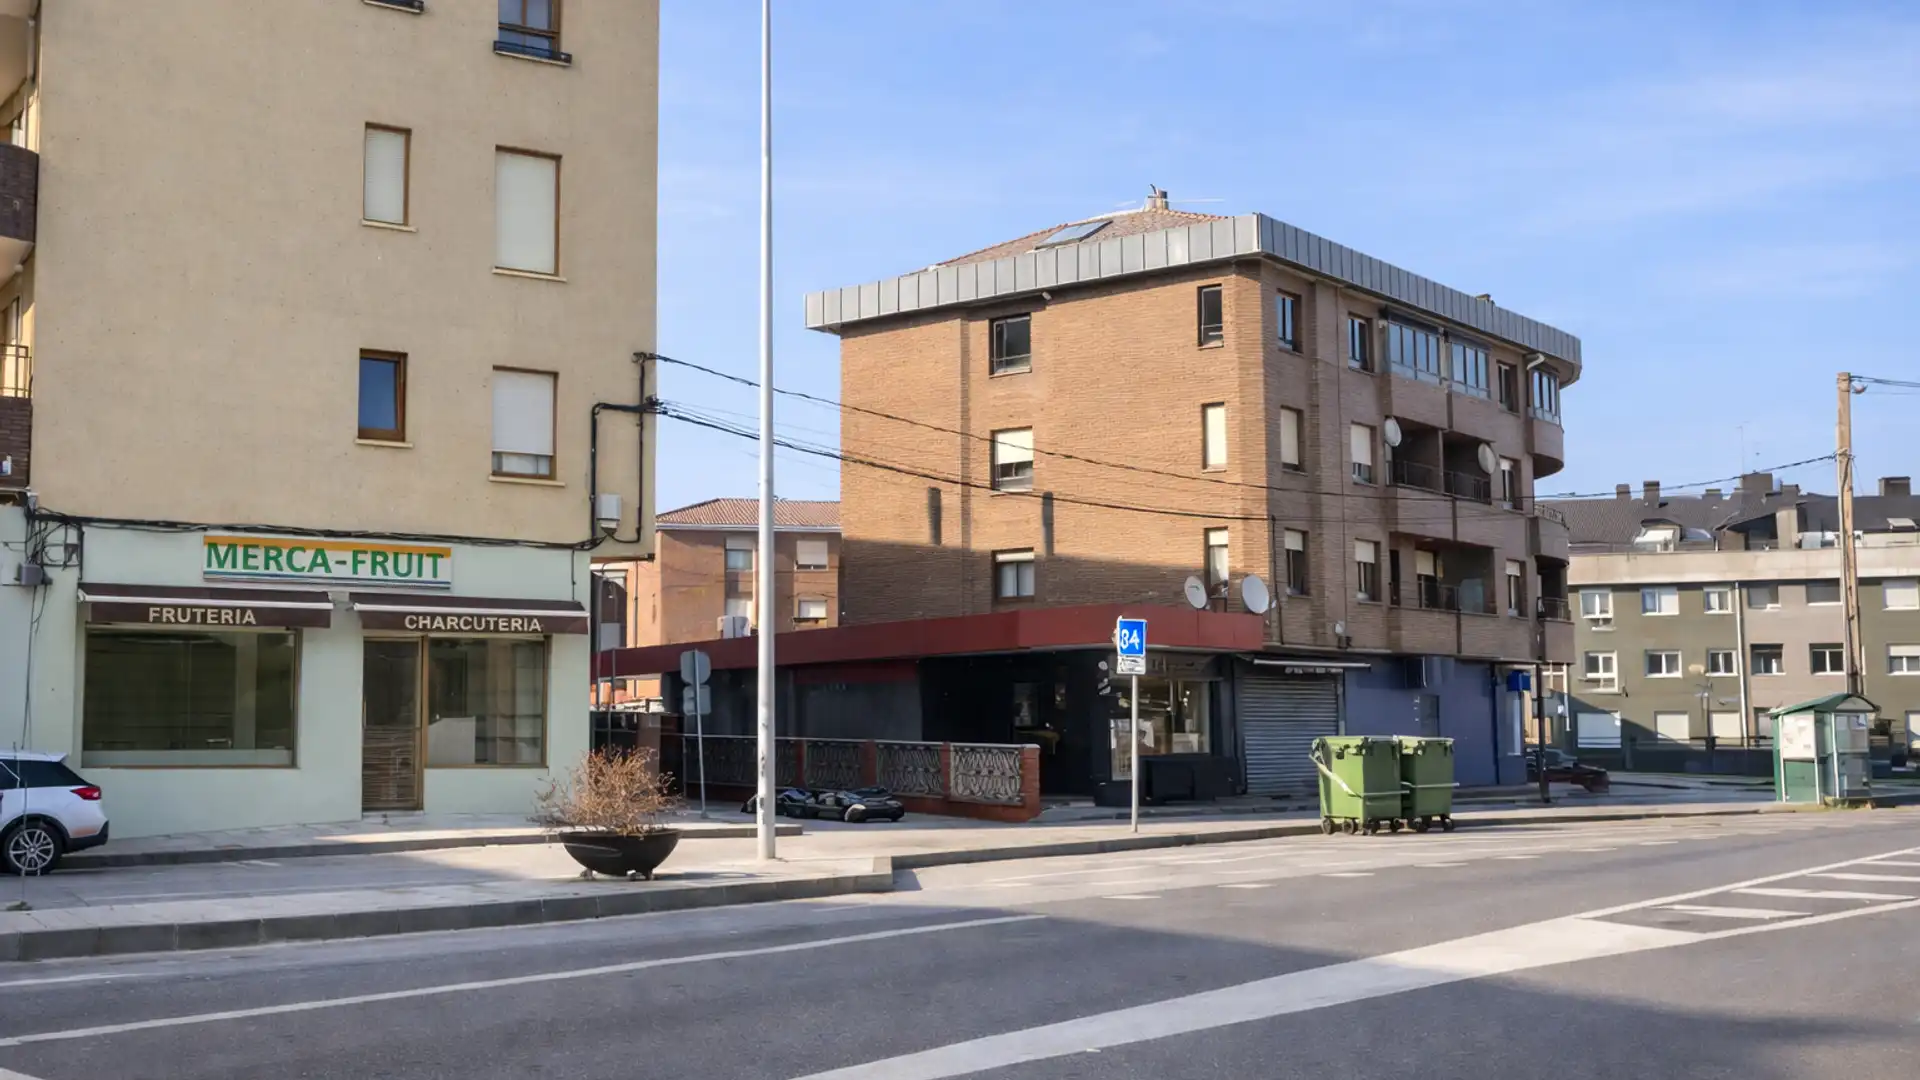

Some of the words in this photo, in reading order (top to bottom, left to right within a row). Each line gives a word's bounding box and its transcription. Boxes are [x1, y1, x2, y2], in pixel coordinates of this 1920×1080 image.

[206, 542, 444, 579] MERCA-FRUIT
[149, 607, 257, 625] FRUTERIA
[404, 614, 542, 632] CHARCUTERIA
